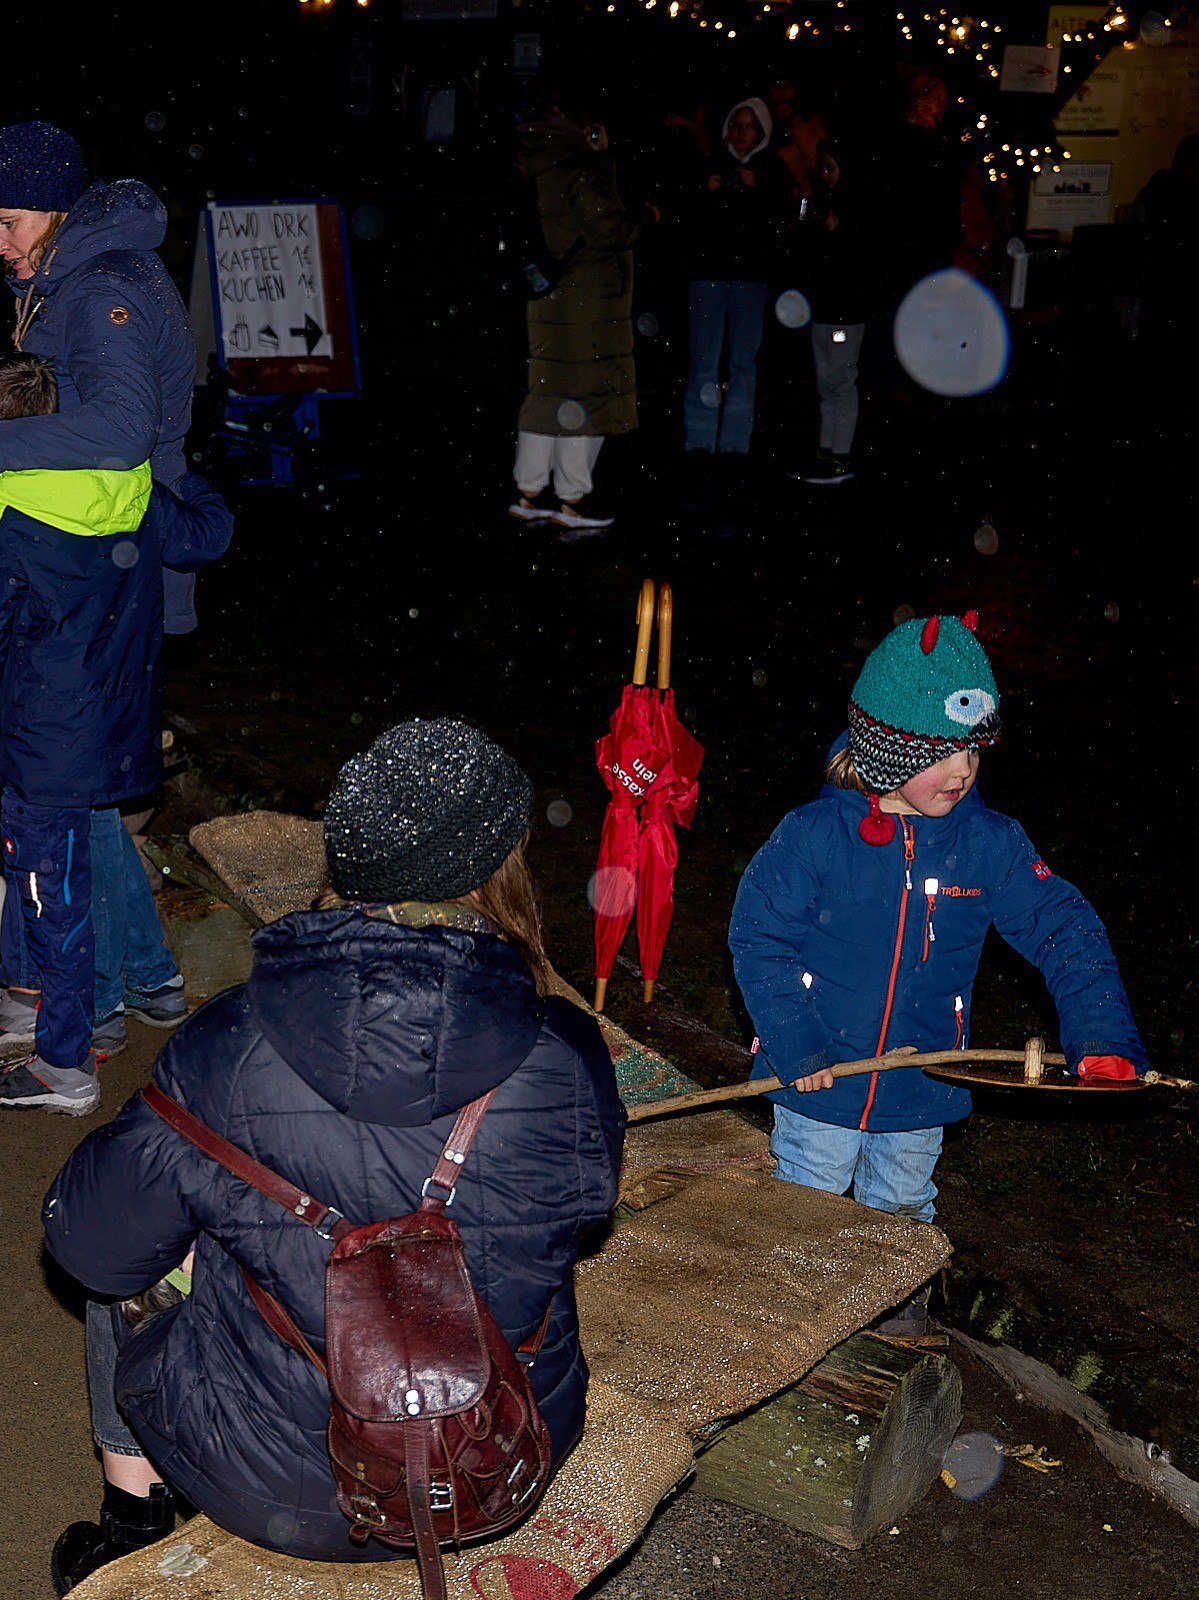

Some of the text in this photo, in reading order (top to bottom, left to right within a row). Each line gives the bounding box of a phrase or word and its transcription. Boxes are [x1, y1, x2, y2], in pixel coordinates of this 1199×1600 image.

[218, 211, 309, 239] AWO DRK
[218, 246, 281, 272] KAFFEE
[220, 274, 285, 303] KUCHEN
